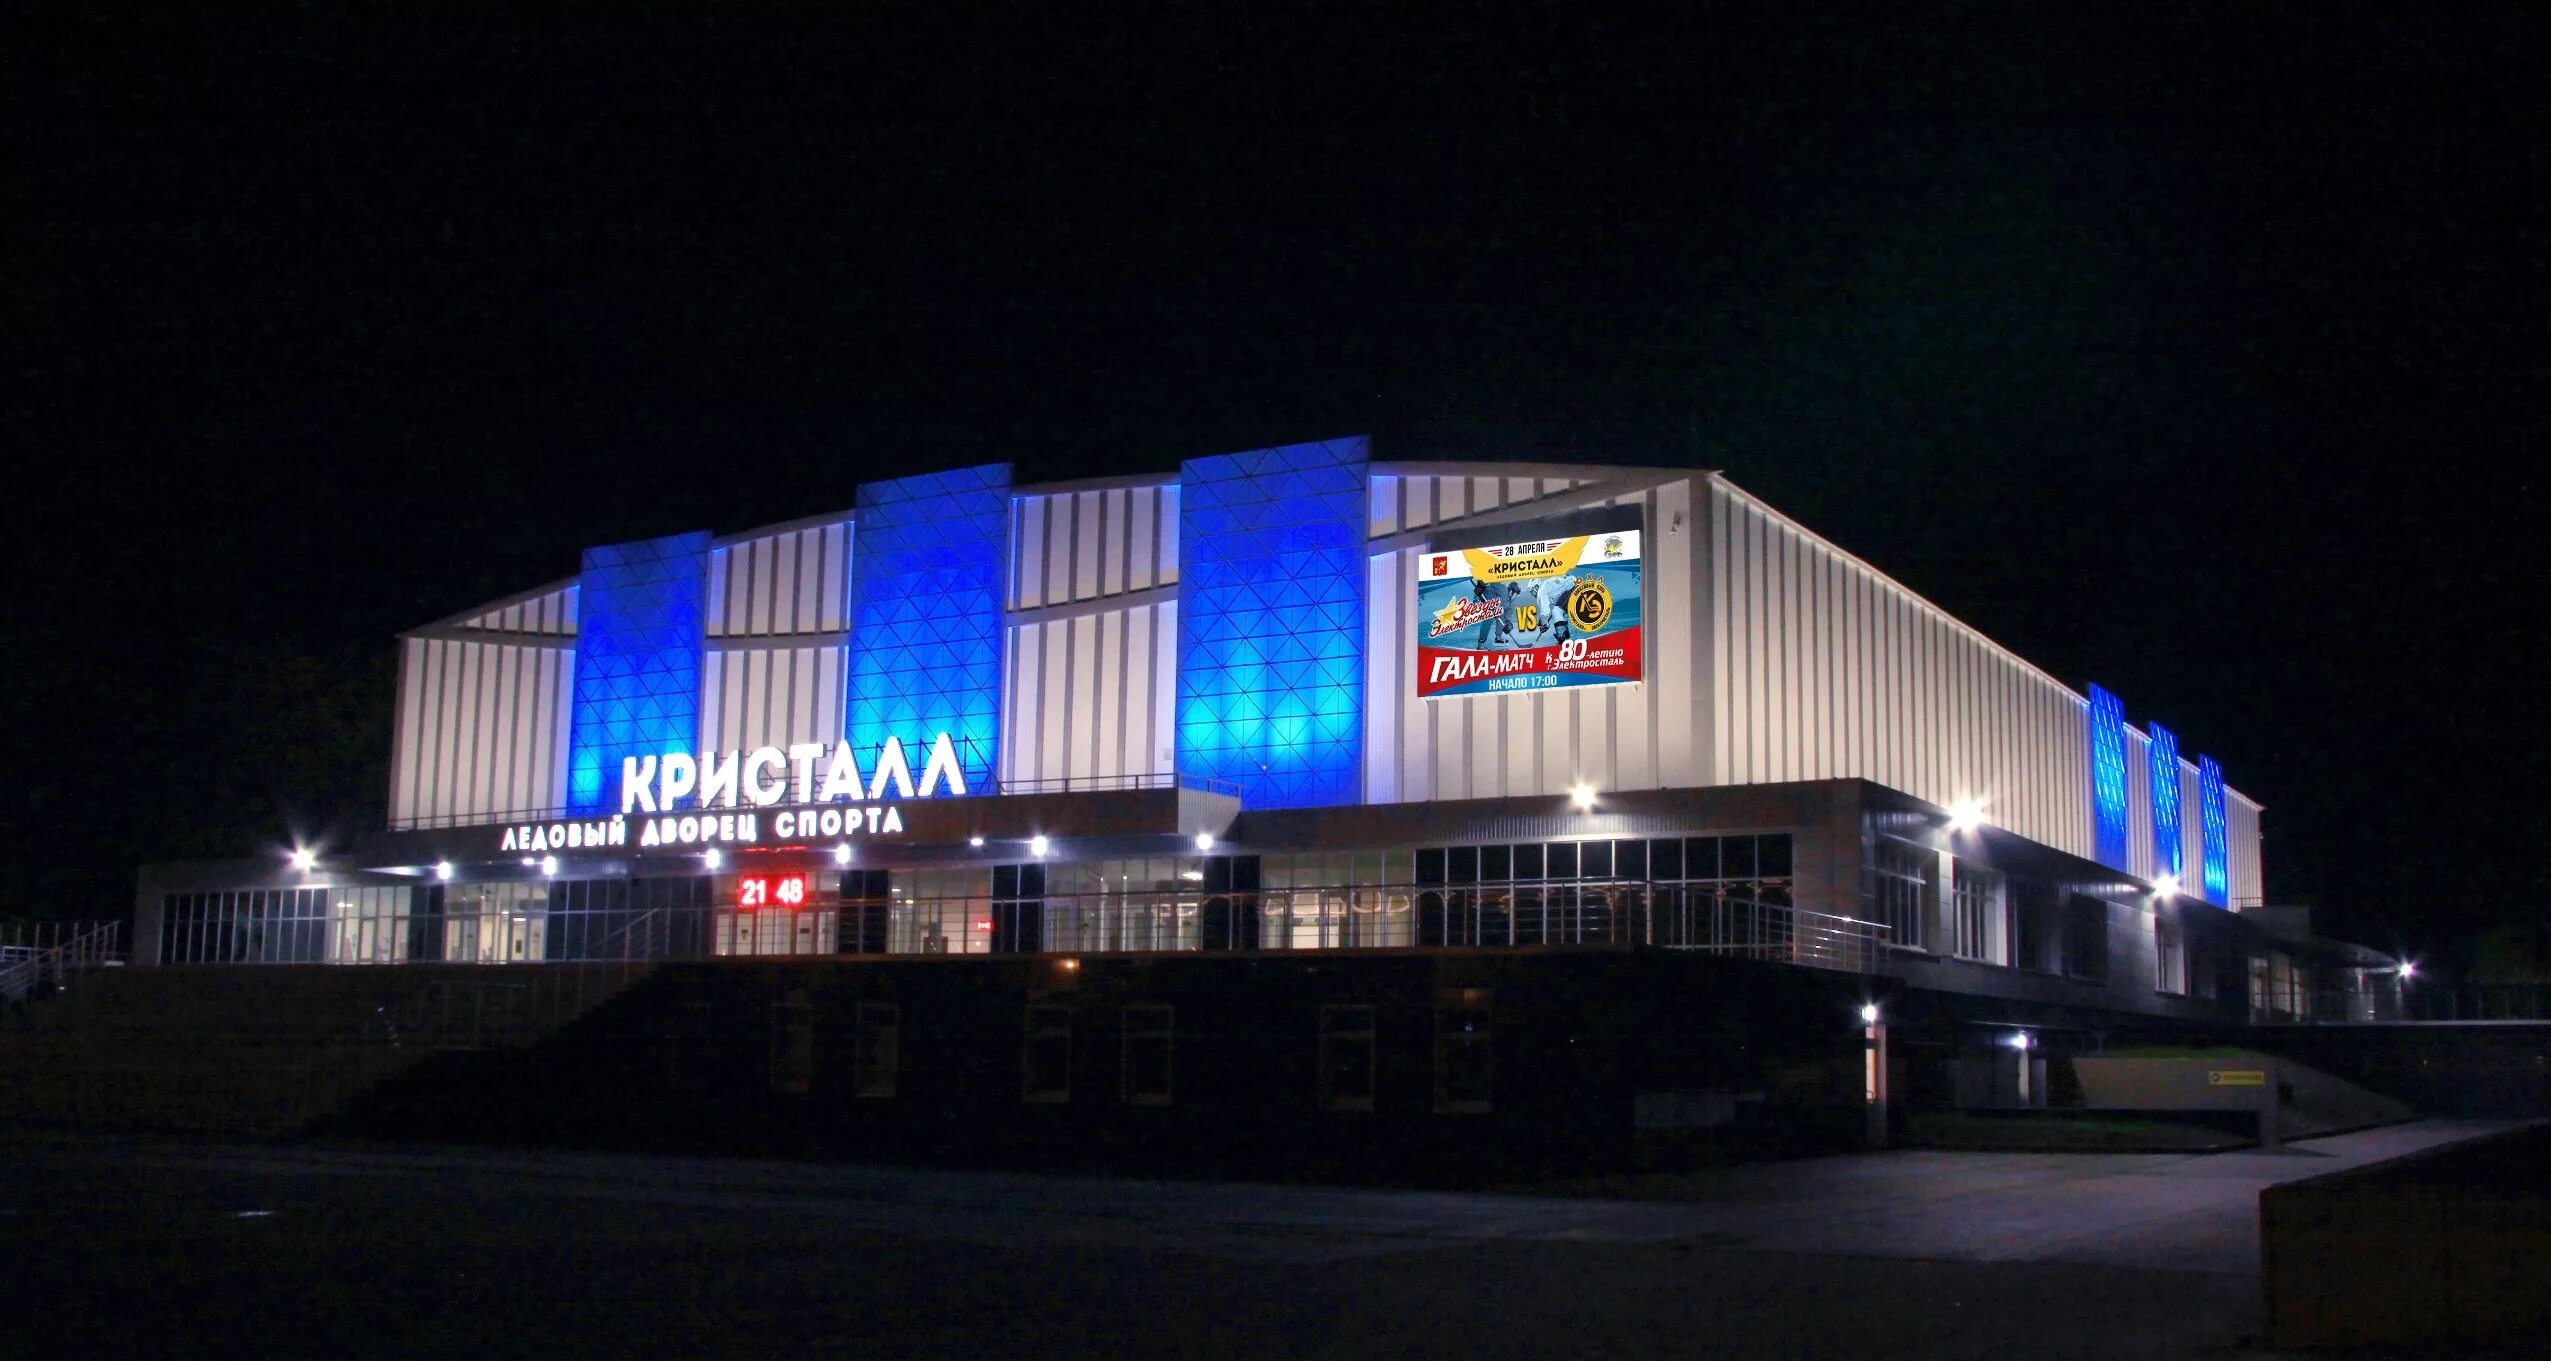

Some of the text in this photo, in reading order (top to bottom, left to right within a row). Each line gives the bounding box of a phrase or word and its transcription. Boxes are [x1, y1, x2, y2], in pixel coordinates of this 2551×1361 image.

[1505, 542, 1545, 556] 28 АПРЕЛЯ
[1488, 558, 1563, 574] «КРИСТАЛЛ»
[1429, 607, 1504, 638] Электростали
[1453, 598, 1501, 621] Звезды
[1516, 605, 1538, 632] VS
[1430, 653, 1534, 684] ГАЛА-МАТЧ
[1489, 675, 1557, 690] НАЧАЛО 17:00
[622, 731, 967, 814] КРИСТАЛЛ
[500, 806, 903, 852] ЛЕДОВЫЙ ДВОРЕЦ СПОРТА
[741, 878, 804, 905] 21 48
